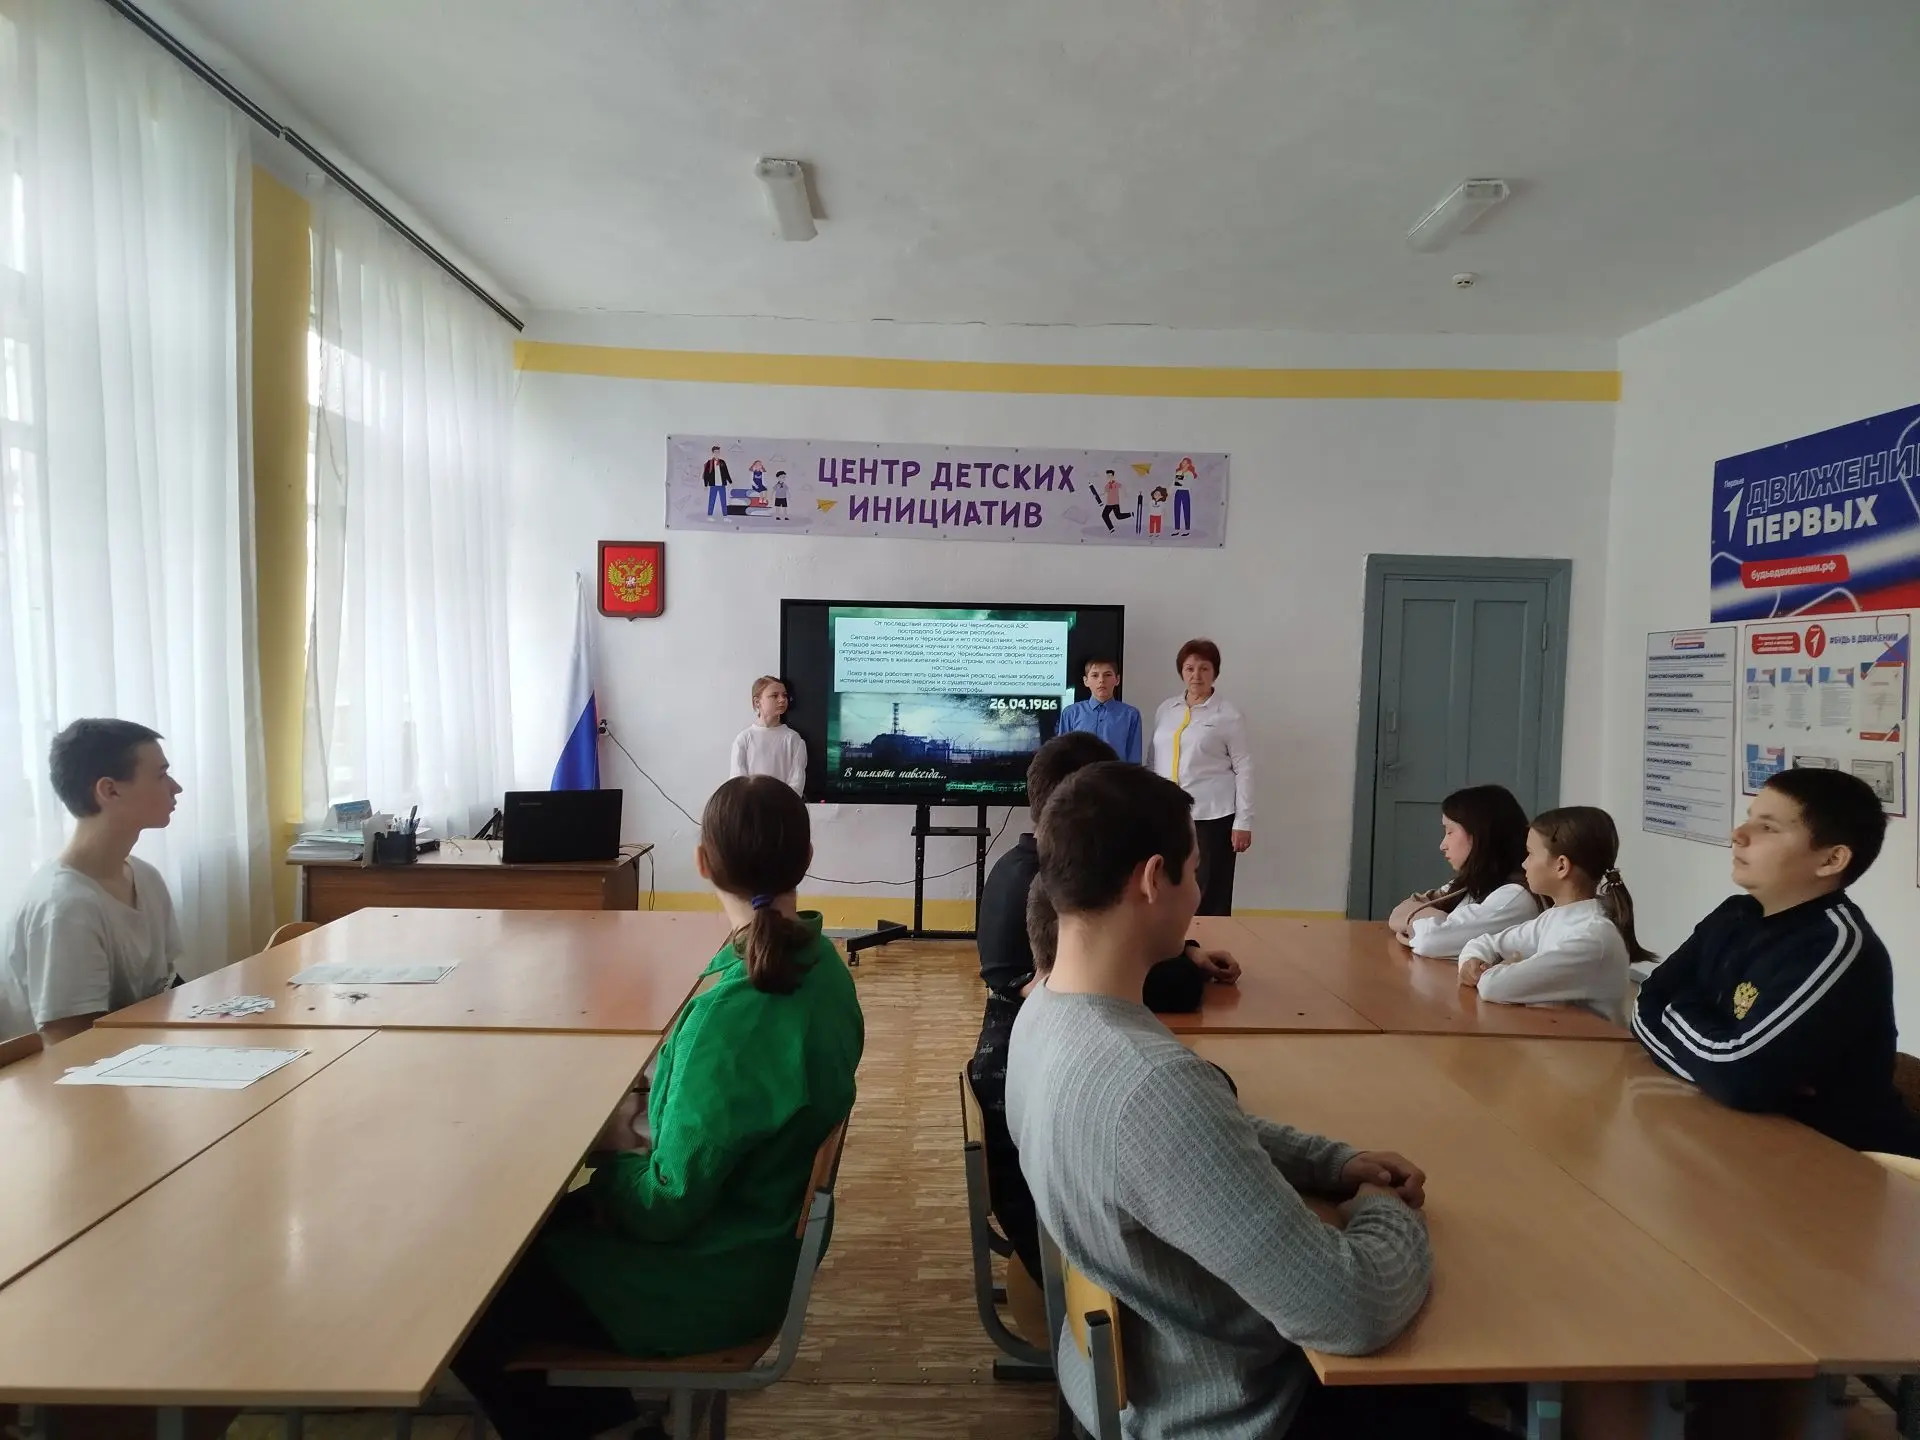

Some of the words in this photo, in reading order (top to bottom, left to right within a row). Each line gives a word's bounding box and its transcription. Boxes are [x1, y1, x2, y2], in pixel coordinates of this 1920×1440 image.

[818, 457, 921, 488] ЦЕНТР
[930, 461, 1076, 493] ДЕТСКИХ
[1746, 443, 1920, 517] ДВИЖЕНИ
[848, 495, 1043, 528] ИНИЦИАТИВ
[1746, 494, 1879, 547] ПЕРВЫХ
[923, 621, 958, 629] катастрофы
[1829, 636, 1850, 645] #БУДЬ
[1857, 633, 1899, 644] ДВИЖЕНИИ
[989, 698, 1058, 711] 26.04.1986
[844, 767, 852, 778] В
[855, 768, 895, 778] памяти
